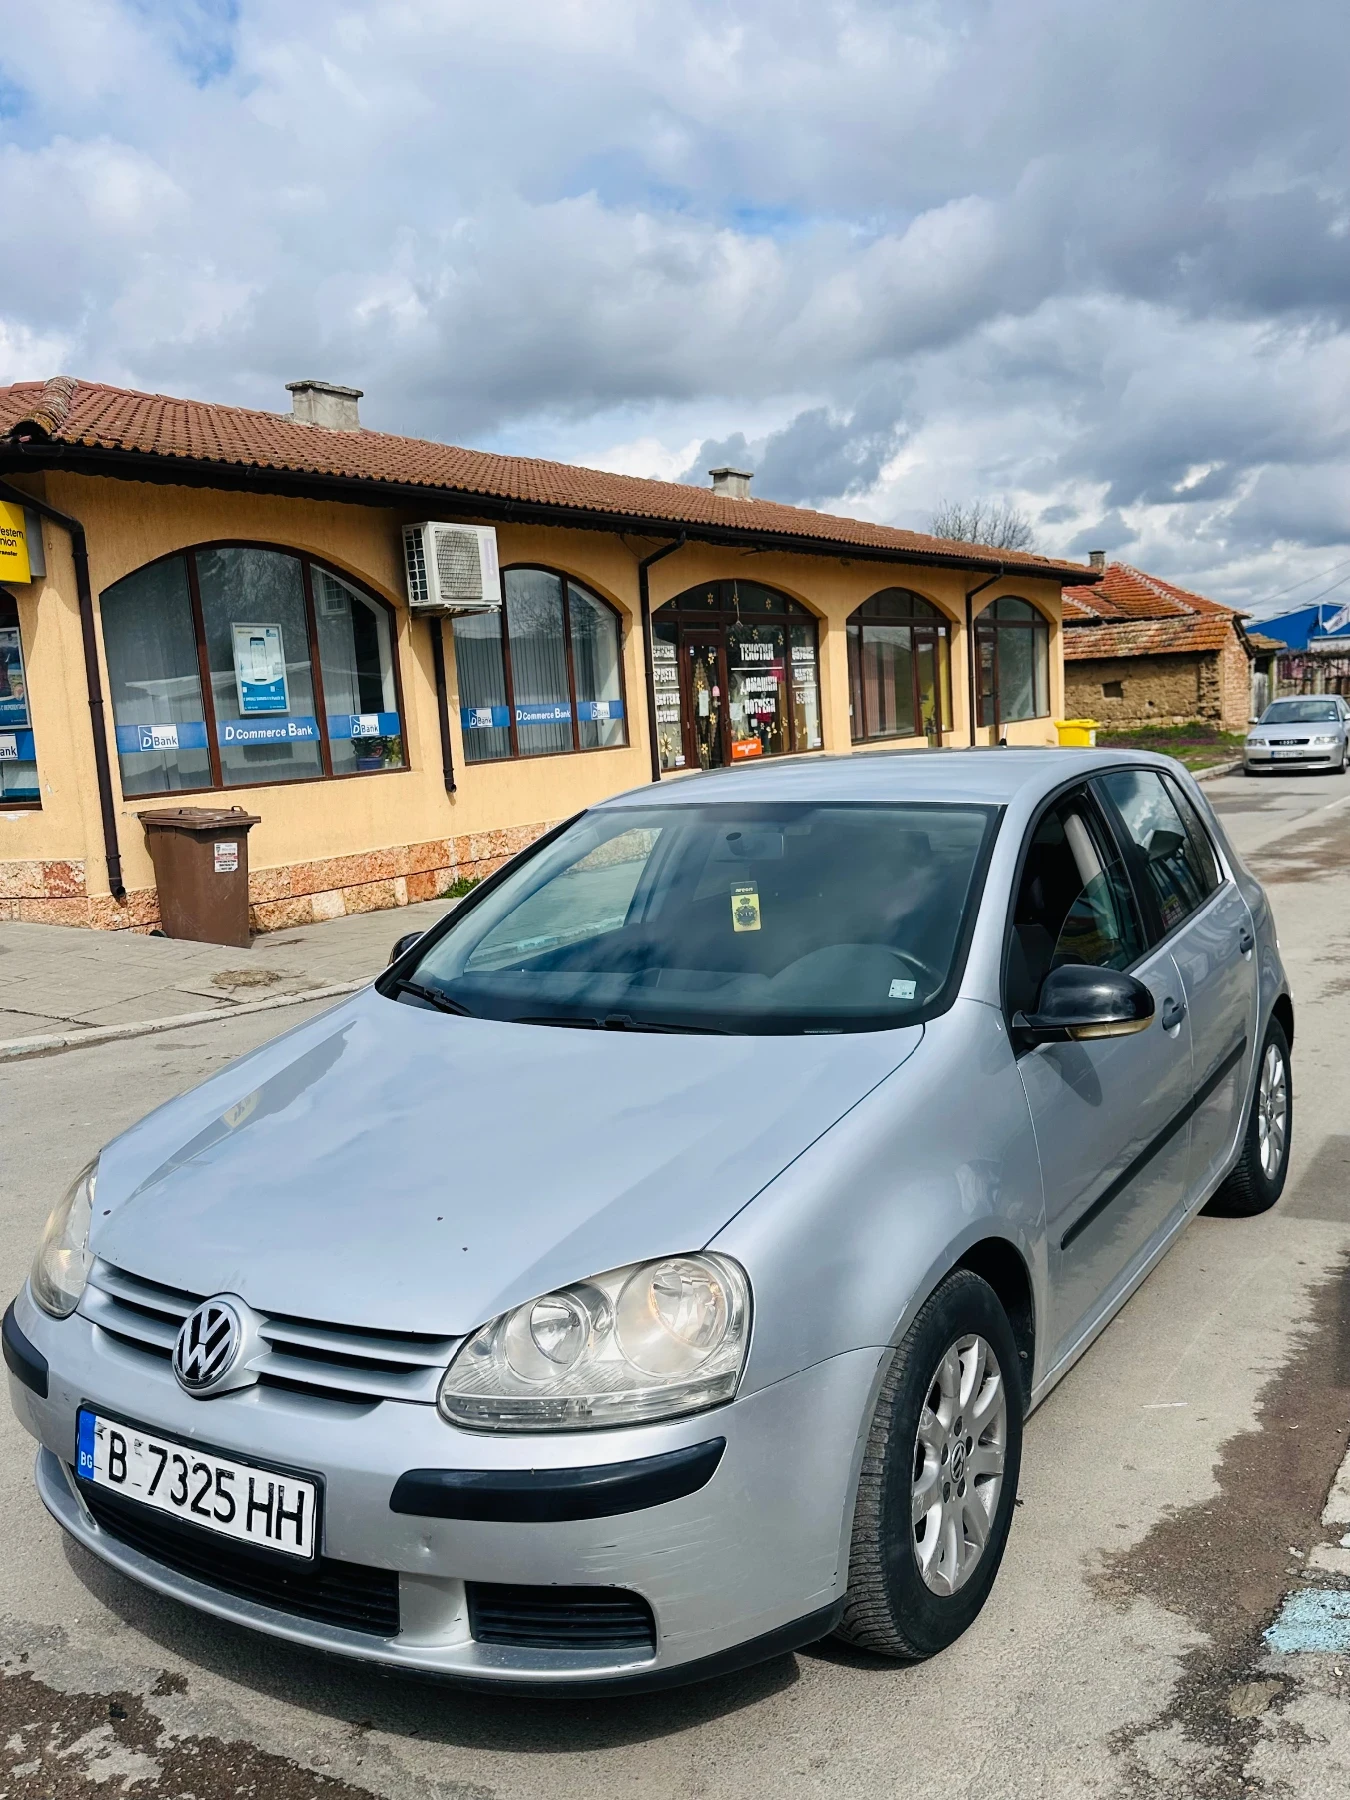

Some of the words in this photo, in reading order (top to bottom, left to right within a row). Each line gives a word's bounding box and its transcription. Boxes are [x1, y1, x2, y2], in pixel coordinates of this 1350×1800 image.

[0, 526, 24, 539] estern
[0, 536, 17, 548] nion
[516, 710, 522, 720] D
[523, 711, 554, 720] Commerce
[554, 708, 571, 718] Bank
[477, 716, 492, 725] Bank
[225, 726, 234, 740] D
[236, 730, 286, 739] Commerce
[288, 723, 313, 736] Bank
[361, 723, 378, 733] Bank
[153, 735, 178, 747] Bank
[0, 745, 17, 757] ank
[80, 1451, 93, 1468] BG
[147, 1444, 236, 1523] 7325
[246, 1476, 305, 1546] HH
